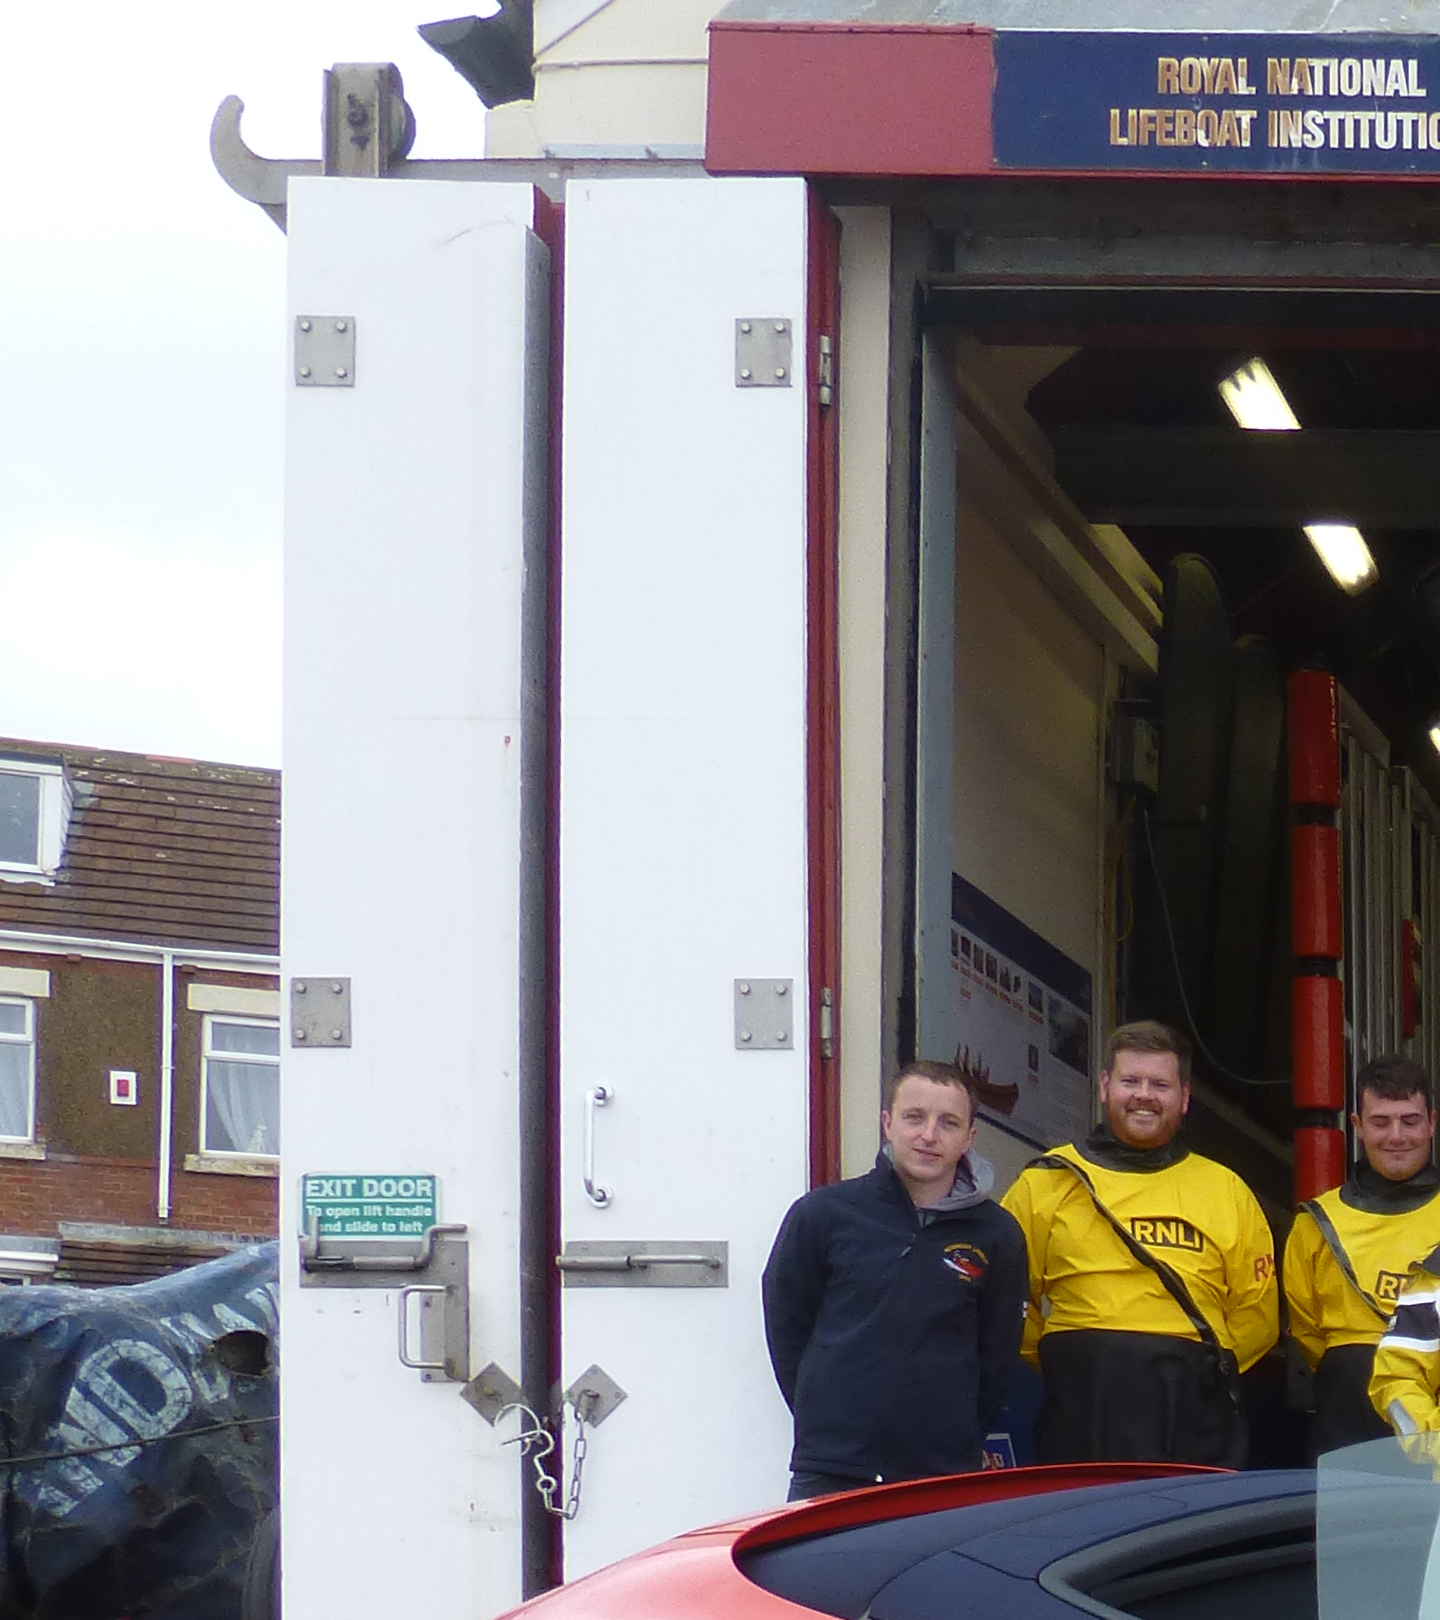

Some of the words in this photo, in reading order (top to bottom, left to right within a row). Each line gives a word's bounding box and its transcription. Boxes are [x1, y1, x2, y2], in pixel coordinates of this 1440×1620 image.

[1158, 57, 1257, 97] ROYAL
[1267, 57, 1427, 99] NATIONAL
[1109, 107, 1259, 149] LIFEBOAT
[306, 1179, 357, 1197] EXIT
[362, 1179, 432, 1197] DOOR
[306, 1205, 321, 1216] To
[325, 1206, 360, 1219] open
[363, 1205, 382, 1217] lift
[386, 1205, 432, 1217] handle
[345, 1221, 378, 1233] slide
[382, 1221, 396, 1233] to
[399, 1221, 424, 1233] left
[1134, 1221, 1202, 1249] RNLI
